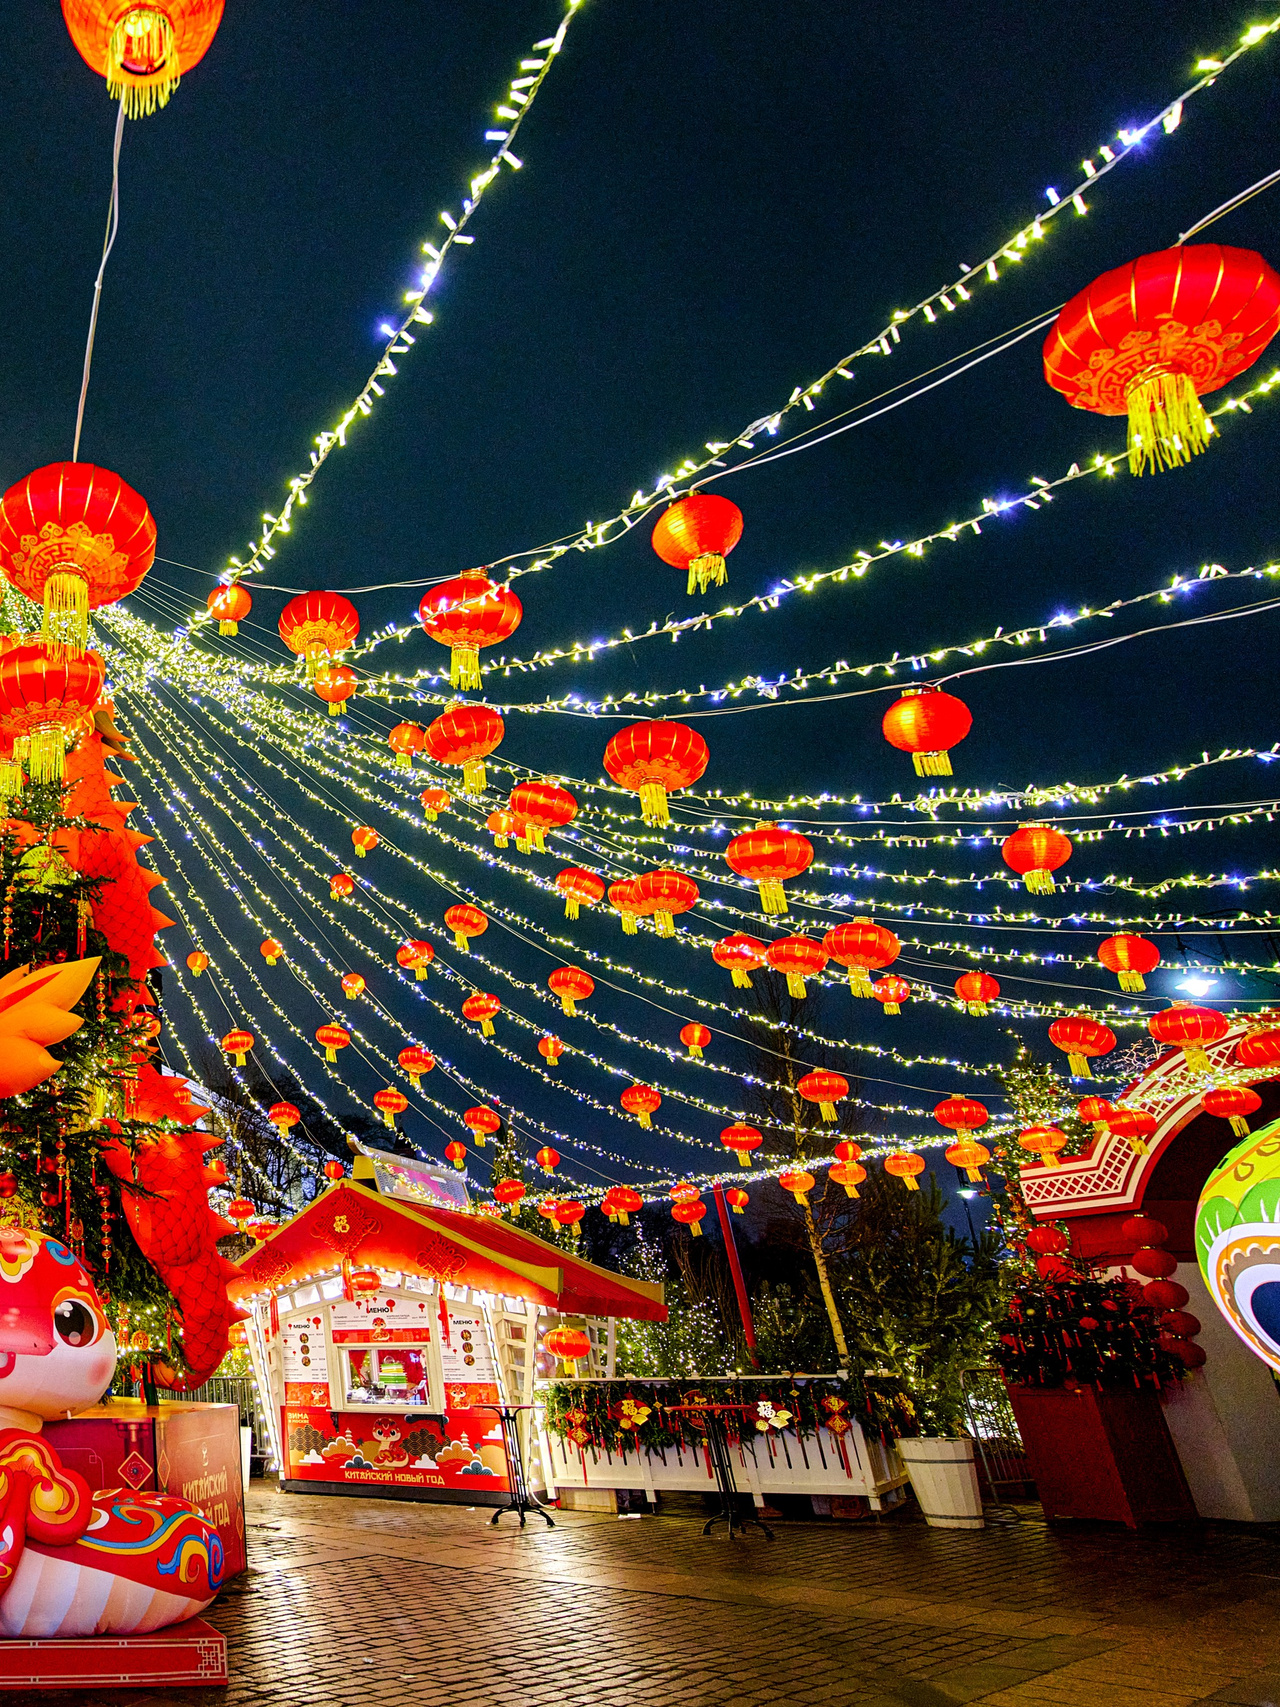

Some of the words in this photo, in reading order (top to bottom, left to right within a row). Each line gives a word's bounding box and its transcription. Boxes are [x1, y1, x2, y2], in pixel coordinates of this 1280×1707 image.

[182, 1465, 228, 1503] КИТАЙСКИЙ
[345, 1470, 392, 1482] КИТАЙСКИЙ
[395, 1472, 424, 1483] НОВЫЙ
[426, 1474, 445, 1485] ГОД
[214, 1500, 231, 1527] ГОД
